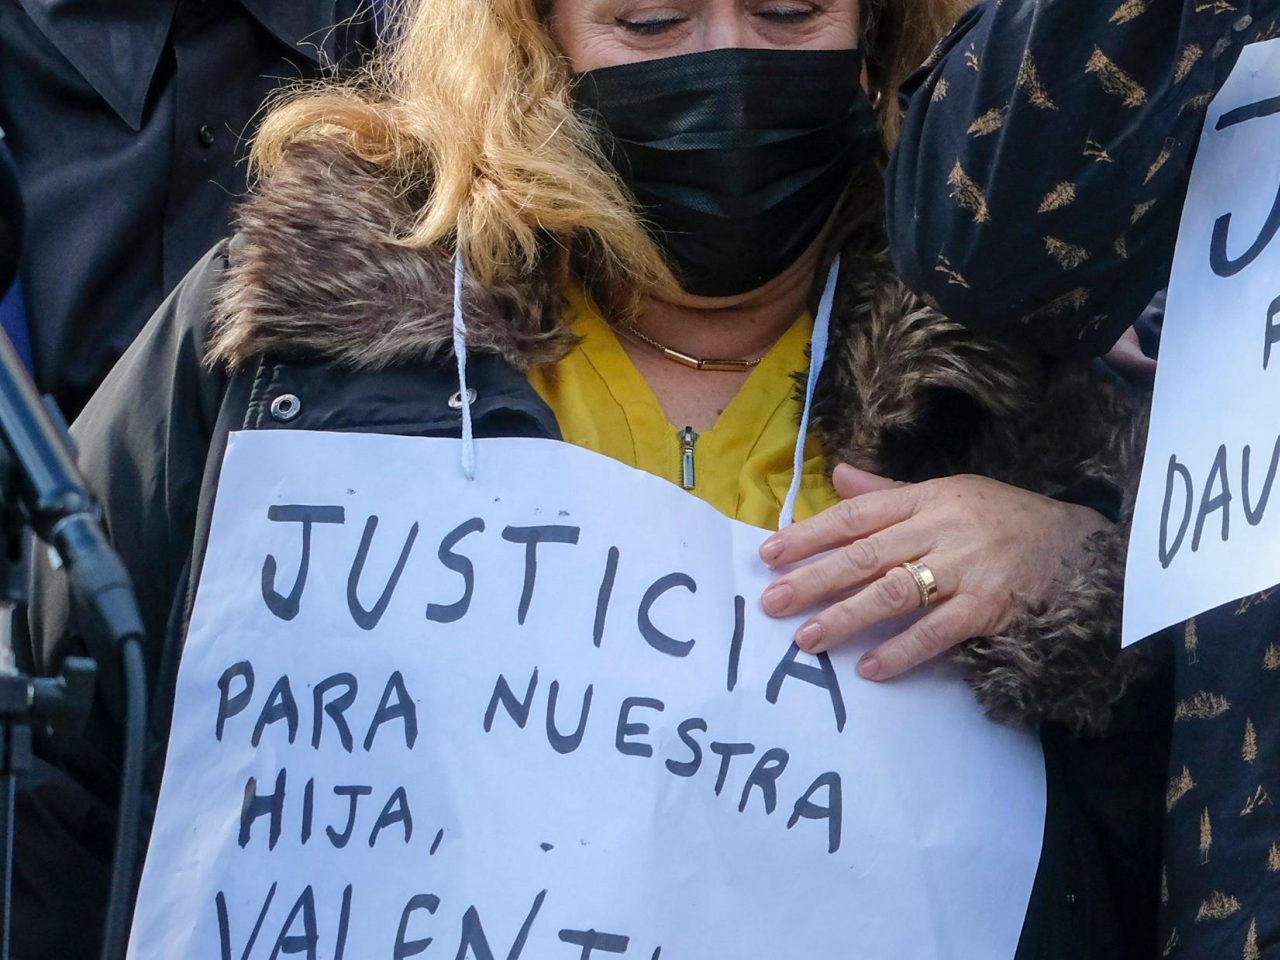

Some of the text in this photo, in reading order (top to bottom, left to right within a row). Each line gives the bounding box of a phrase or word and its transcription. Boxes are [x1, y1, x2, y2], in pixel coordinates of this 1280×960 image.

[260, 504, 848, 734] JUSTICIA
[215, 660, 843, 855] PARA NUESTRA
[237, 767, 445, 857] HIJA,
